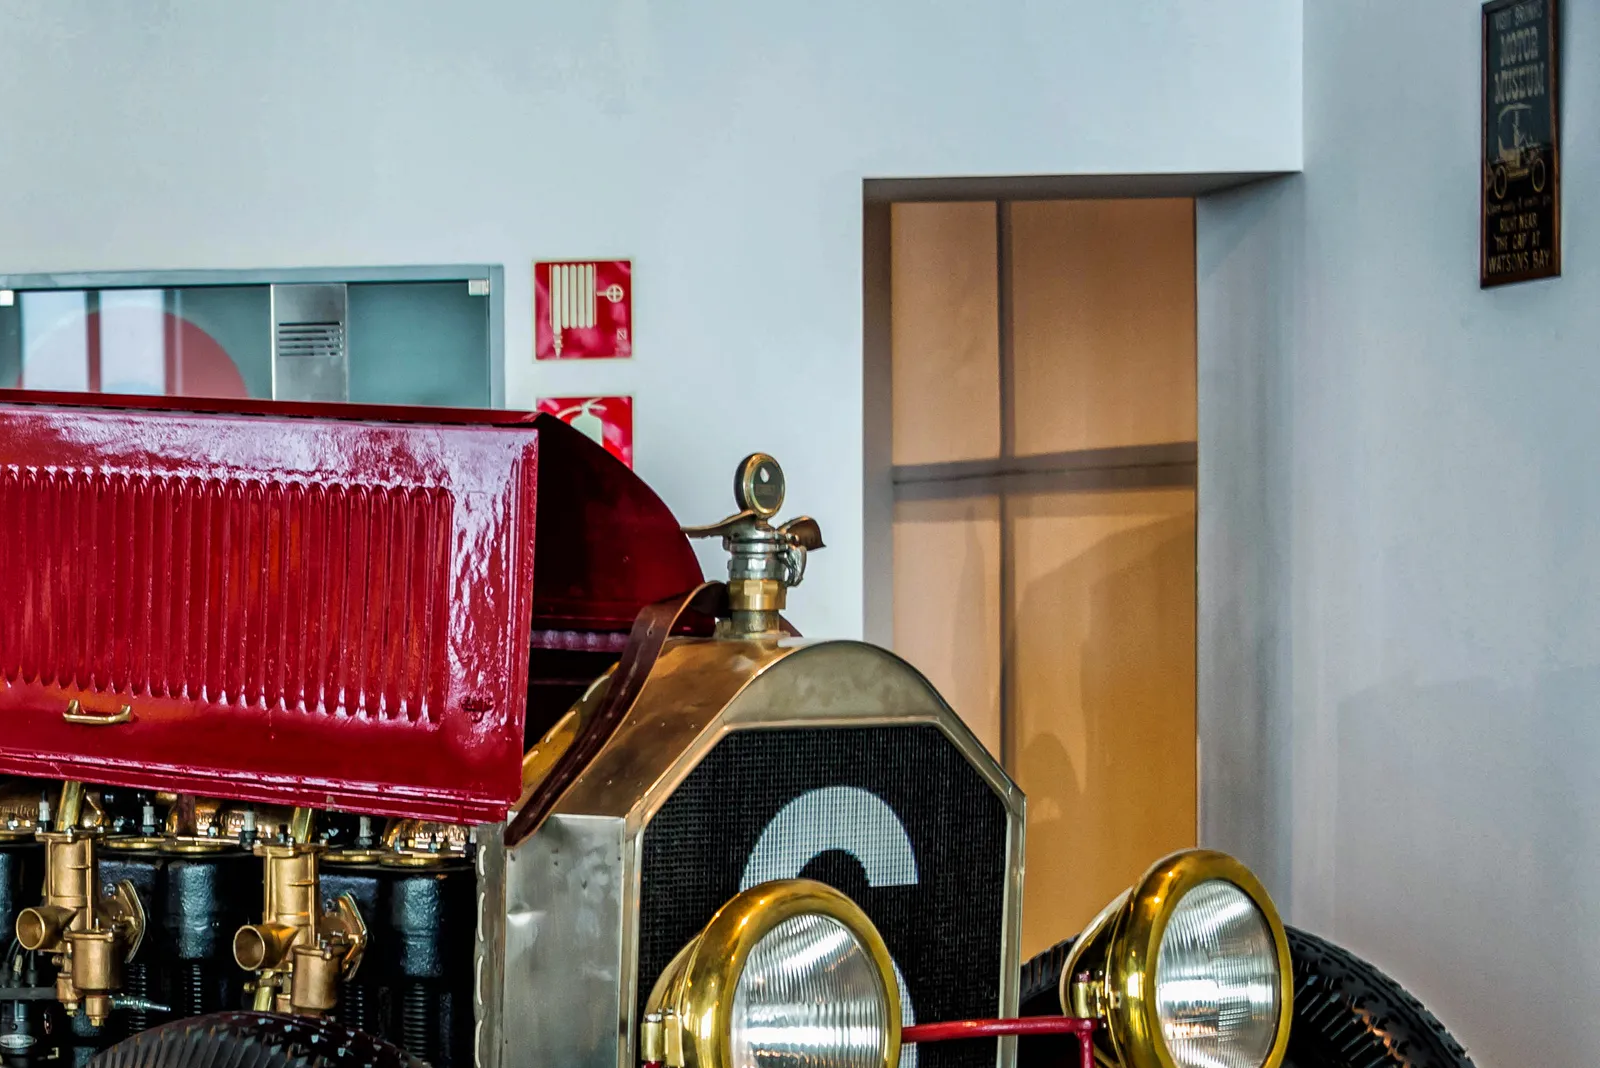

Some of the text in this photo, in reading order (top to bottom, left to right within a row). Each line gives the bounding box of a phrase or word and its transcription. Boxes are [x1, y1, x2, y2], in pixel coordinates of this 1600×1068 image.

[1500, 26, 1538, 67] MOTOR
[1494, 61, 1544, 104] MUSEUM
[1532, 248, 1550, 269] BAY
